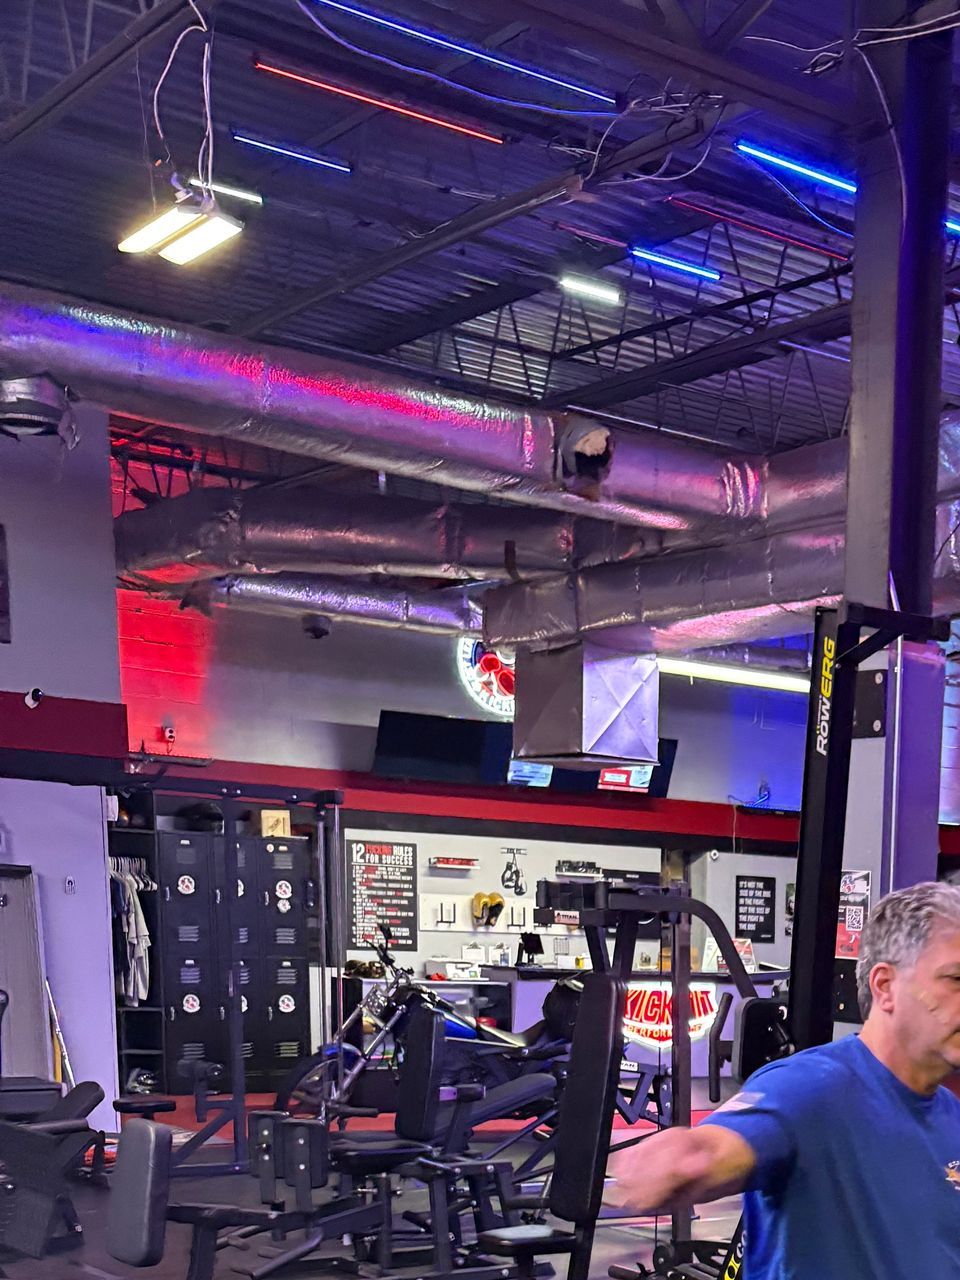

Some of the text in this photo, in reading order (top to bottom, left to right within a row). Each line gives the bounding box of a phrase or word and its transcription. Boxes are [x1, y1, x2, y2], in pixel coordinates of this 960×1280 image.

[351, 842, 365, 863] 12
[392, 845, 413, 857] RULES
[365, 853, 413, 866] FOR SUCCESS
[623, 989, 714, 1025] KICKIT
